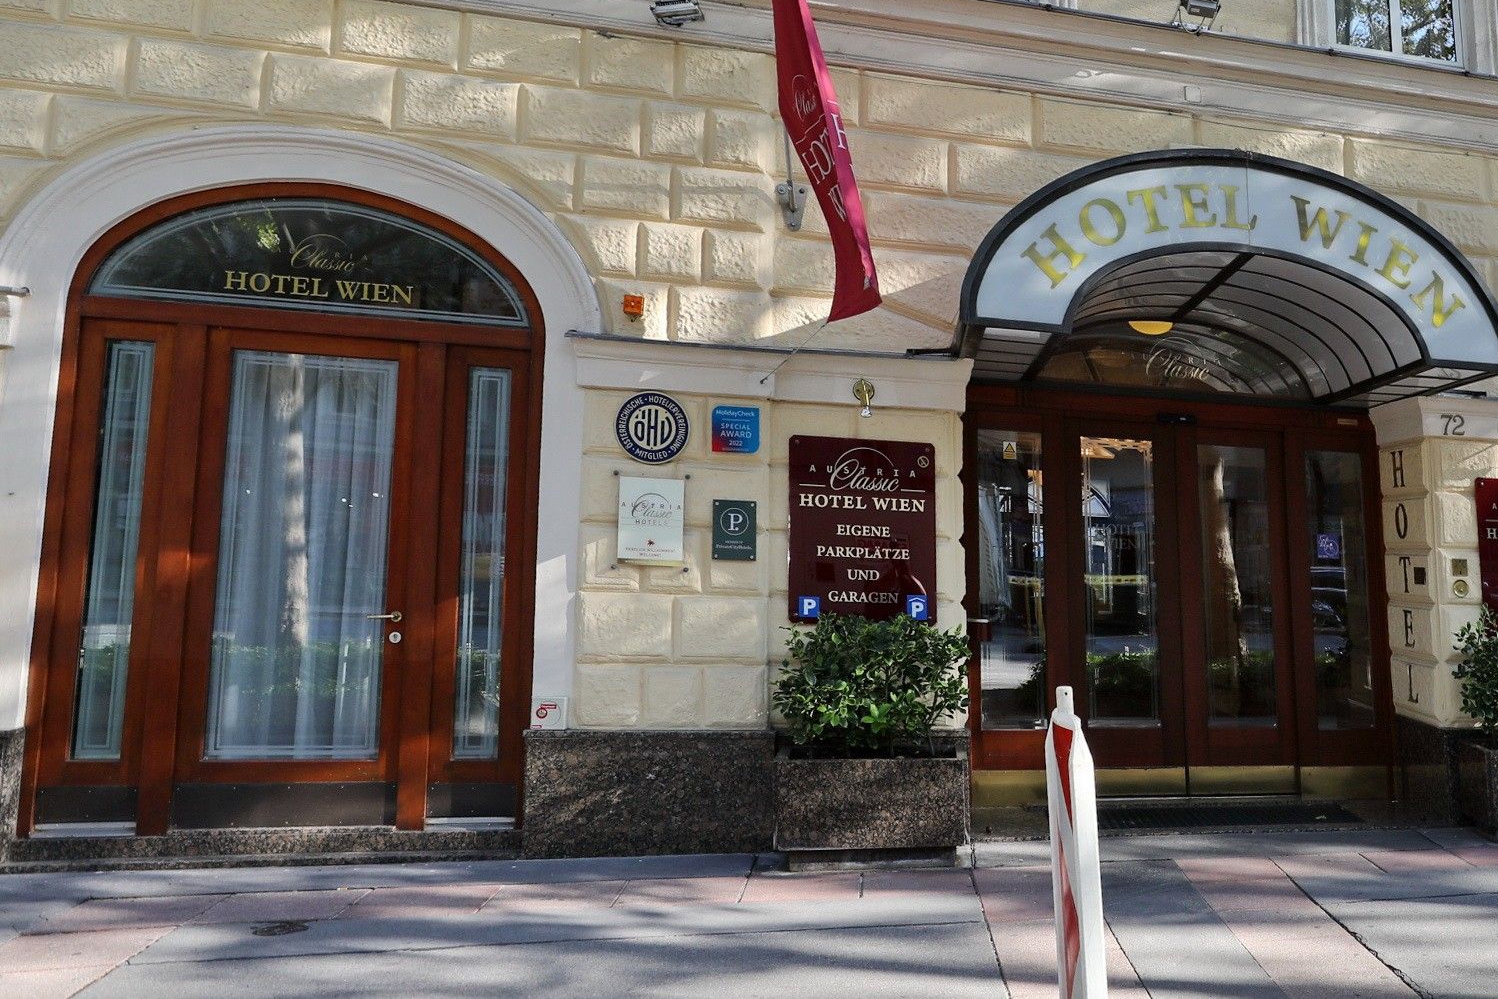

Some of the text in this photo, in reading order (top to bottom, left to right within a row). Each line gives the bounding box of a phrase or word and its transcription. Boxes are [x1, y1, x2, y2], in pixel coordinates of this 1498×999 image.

[290, 244, 356, 272] Classic
[1020, 183, 1467, 330] HOTEL WIEN
[223, 270, 414, 305] HOTEL WIEN
[720, 422, 751, 430] SPECIAL
[1440, 414, 1466, 436] 72
[720, 430, 752, 439] AWARD
[634, 448, 668, 460] MITGLIED
[809, 464, 916, 478] AUSTRIA
[830, 459, 900, 492] Classic
[620, 501, 681, 510] AUSTRIA
[799, 493, 926, 513] HOTEL WIEN
[635, 519, 669, 527] HOTELS
[836, 524, 891, 538] EIGENE
[817, 545, 910, 560] PARKPLÄTZE
[847, 568, 880, 581] UND
[1389, 450, 1419, 704] HOTEL
[828, 590, 899, 603] GARAGEN
[803, 598, 817, 615] P
[911, 601, 924, 619] P
